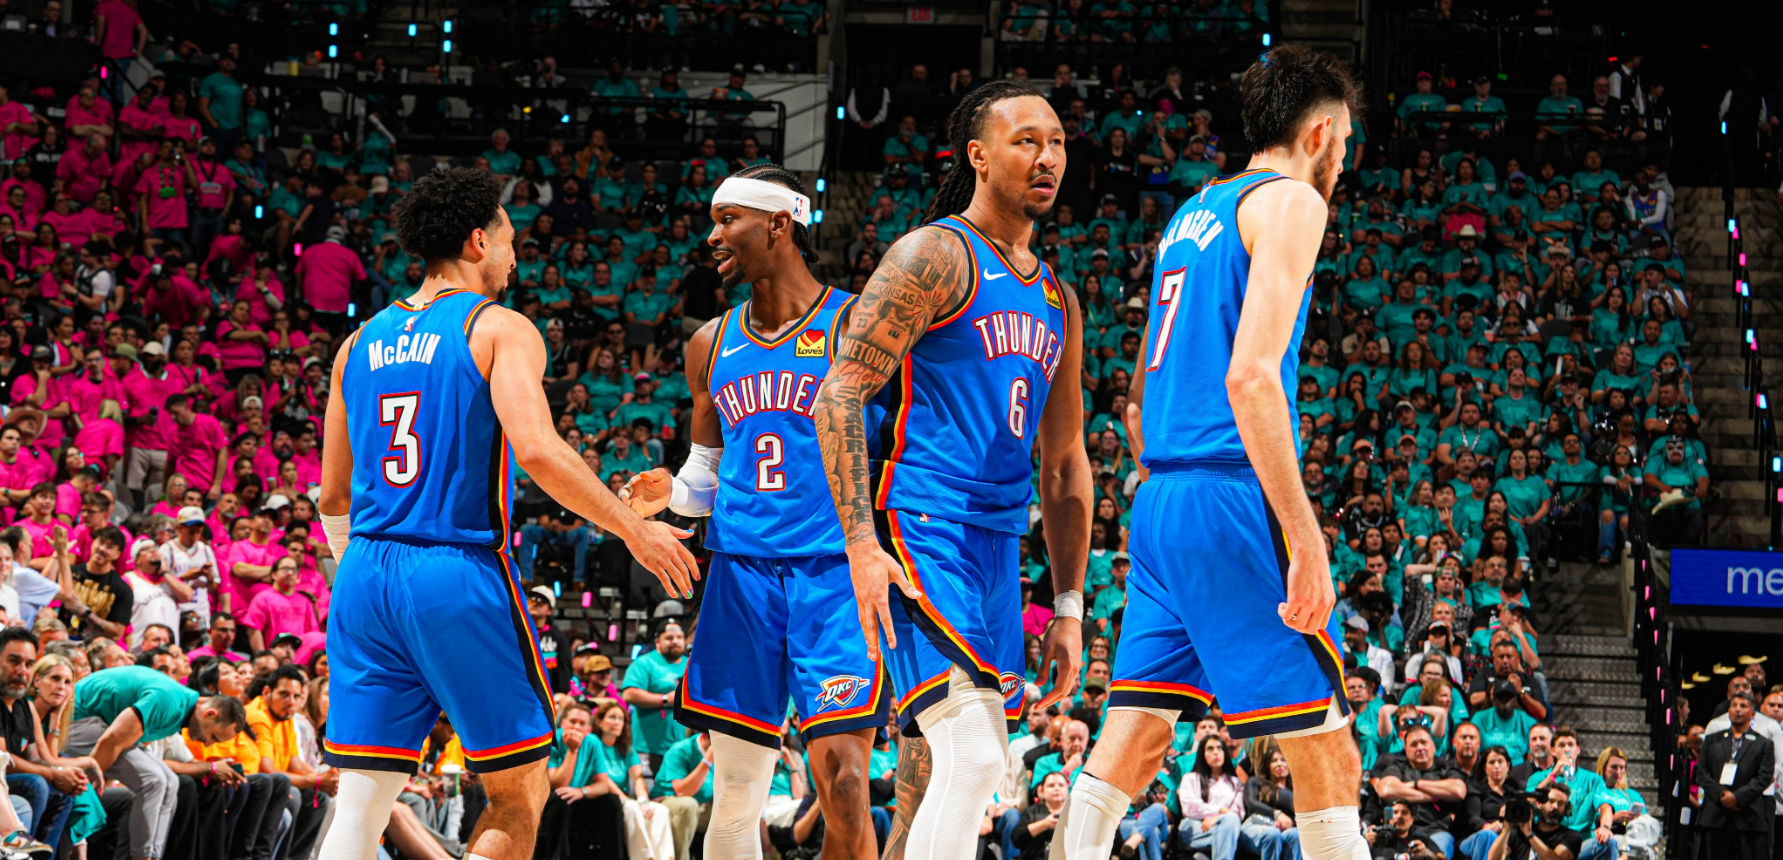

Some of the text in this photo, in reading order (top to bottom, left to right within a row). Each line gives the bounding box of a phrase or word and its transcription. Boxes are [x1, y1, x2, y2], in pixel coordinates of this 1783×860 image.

[911, 6, 932, 21] EXIT
[869, 281, 916, 306] ARKANSAS
[1146, 265, 1187, 372] 7
[368, 332, 441, 372] McCAIN
[838, 337, 898, 376] METOWN
[839, 360, 886, 387] Hero
[1008, 377, 1030, 440] 6
[378, 390, 422, 488] 3
[754, 432, 786, 492] 2
[844, 397, 872, 525] SACRIFICE
[824, 680, 853, 702] OKC
